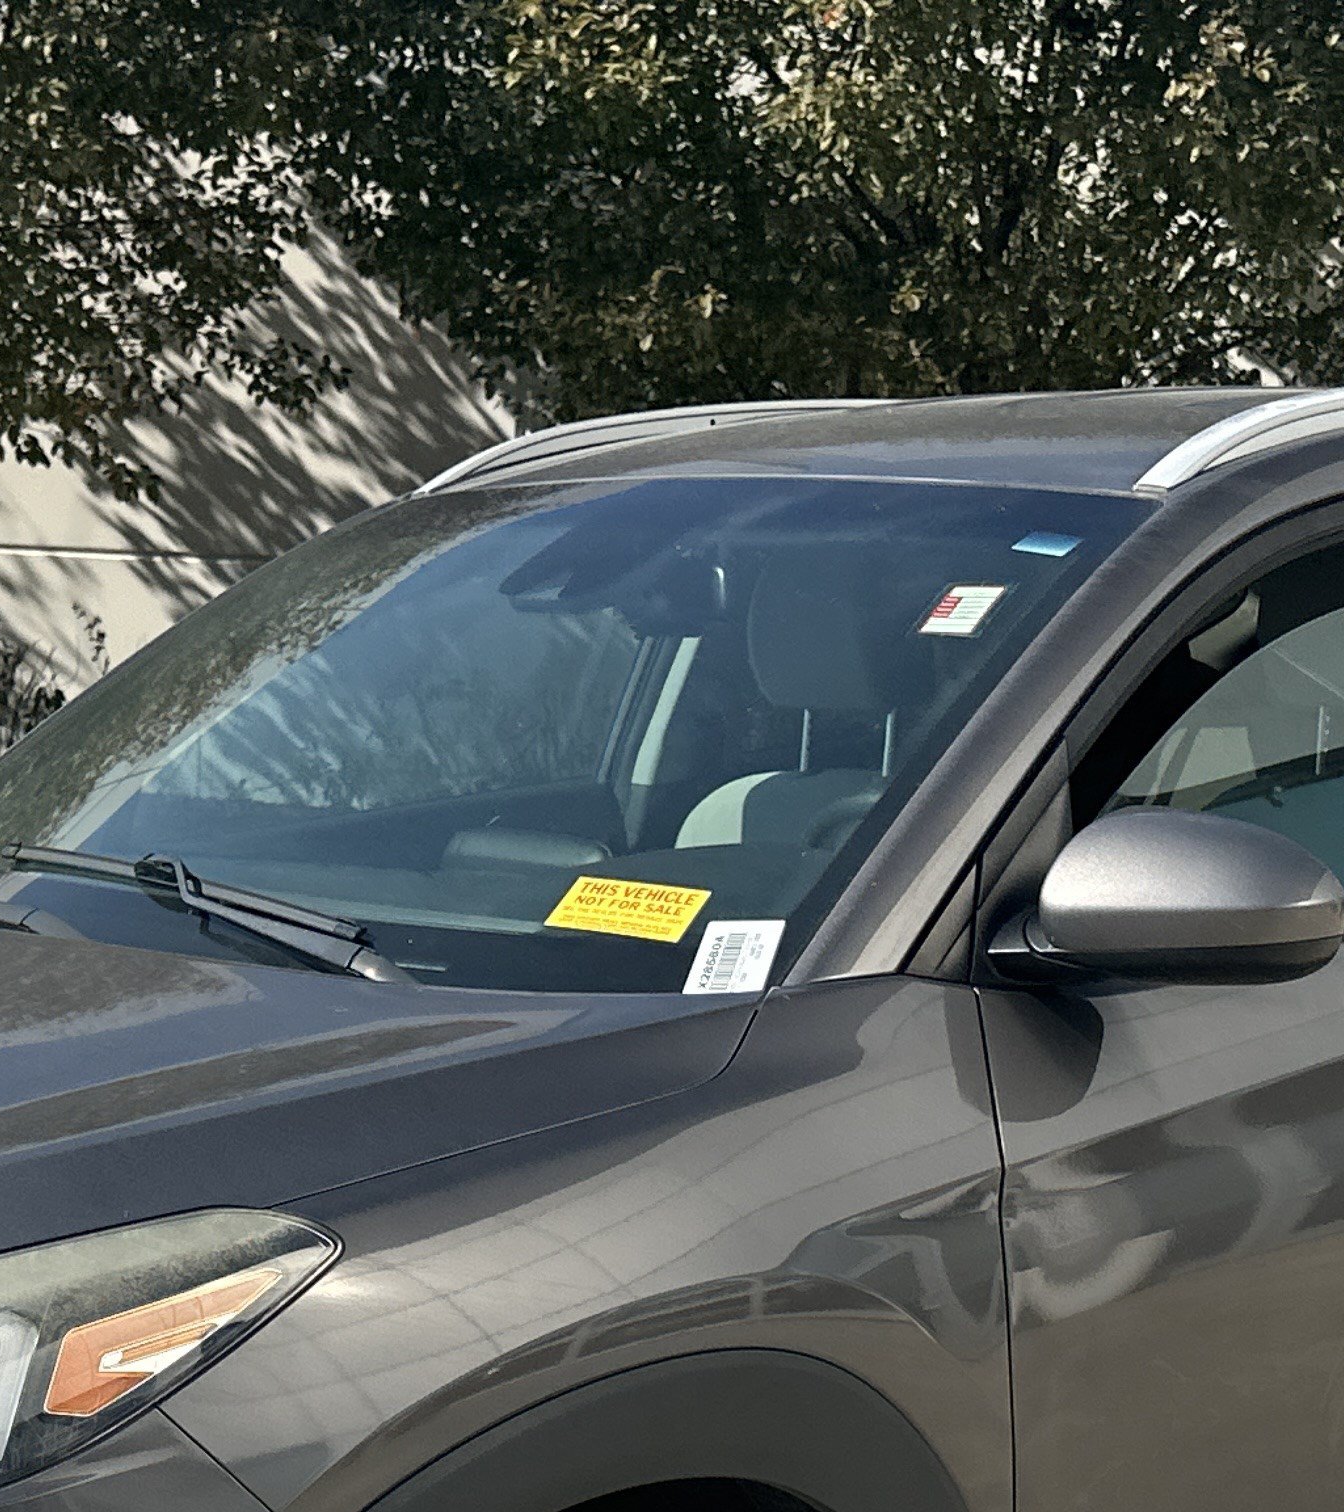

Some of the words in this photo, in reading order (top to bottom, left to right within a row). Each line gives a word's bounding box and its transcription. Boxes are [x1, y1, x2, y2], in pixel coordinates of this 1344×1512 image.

[574, 894, 603, 907] NOT
[608, 899, 641, 911] FOR
[644, 903, 686, 916] SALE
[580, 881, 620, 897] THIS
[624, 885, 699, 906] VEHICLE
